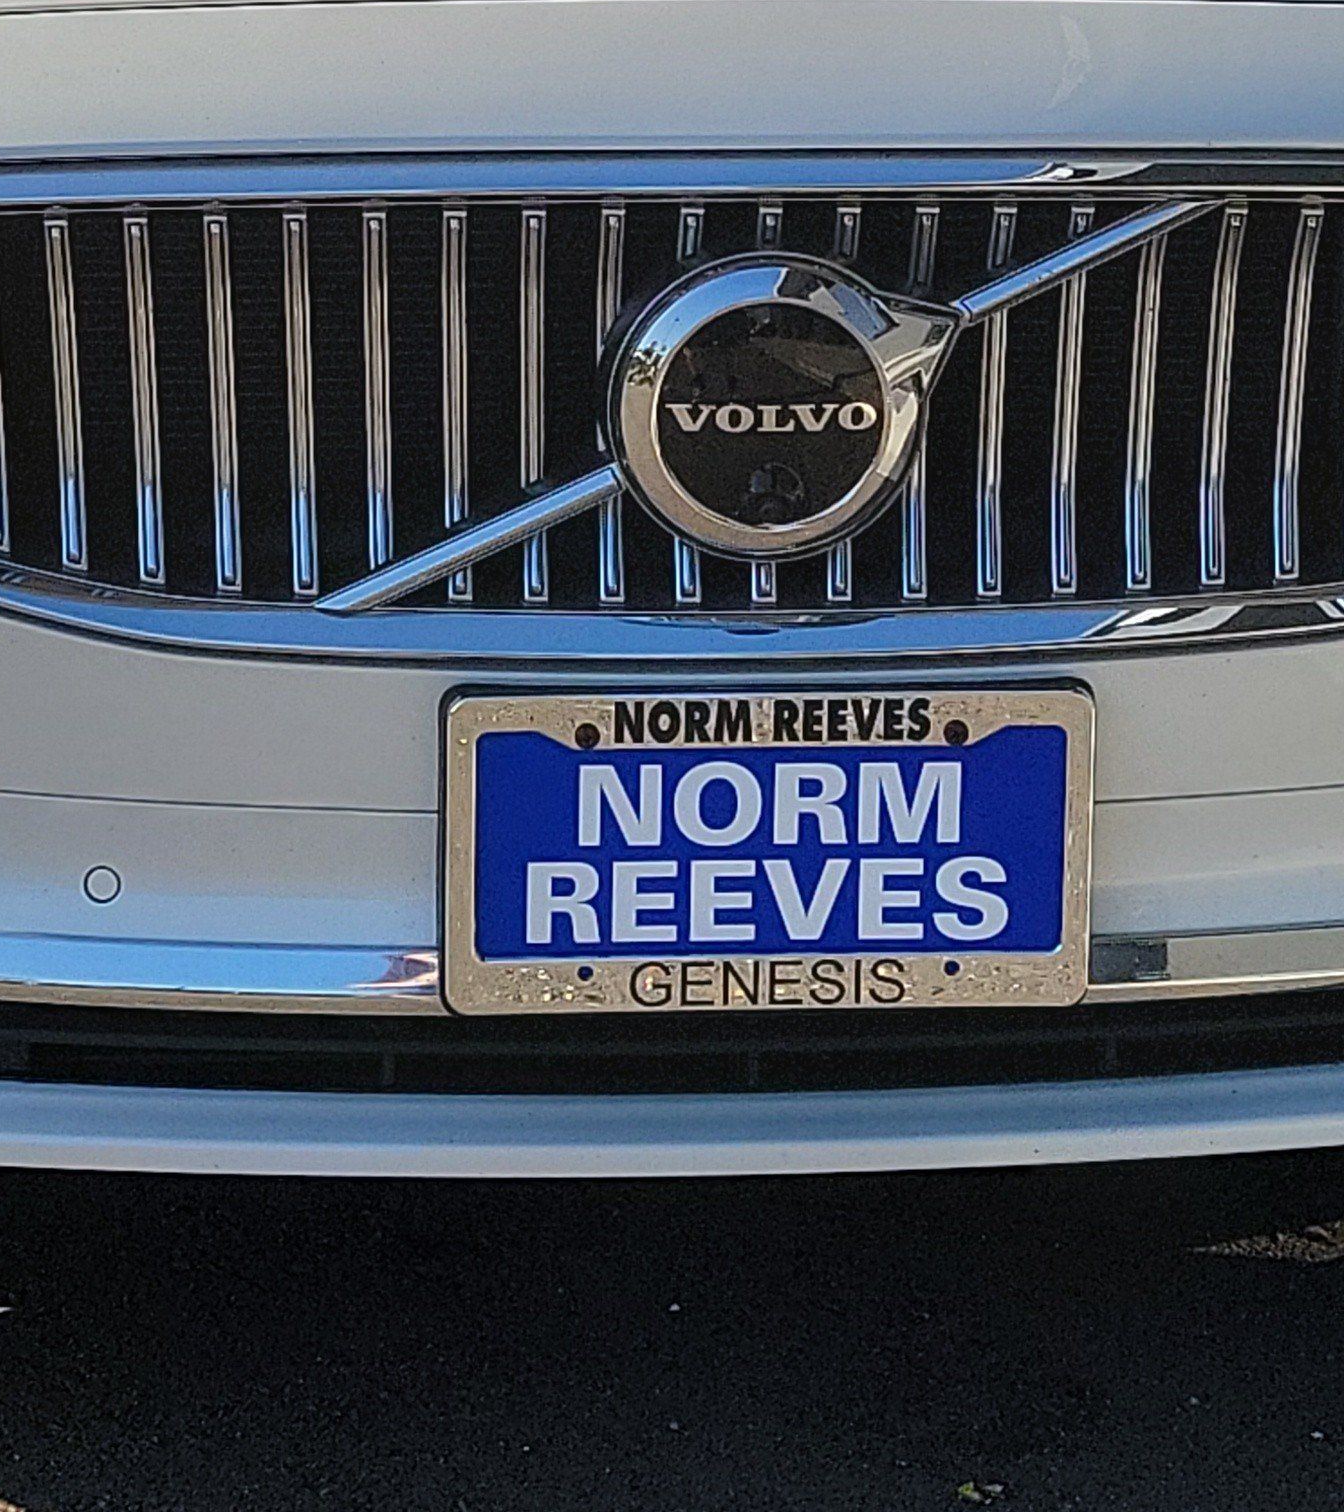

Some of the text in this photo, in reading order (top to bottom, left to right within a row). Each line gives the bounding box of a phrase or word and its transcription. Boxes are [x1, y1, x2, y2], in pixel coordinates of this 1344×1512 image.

[664, 401, 878, 433] VOLVO
[613, 697, 932, 745] NORM REEVES
[578, 760, 963, 847] NORM
[525, 856, 1010, 944] REEVES
[629, 959, 906, 1008] GENESIS
